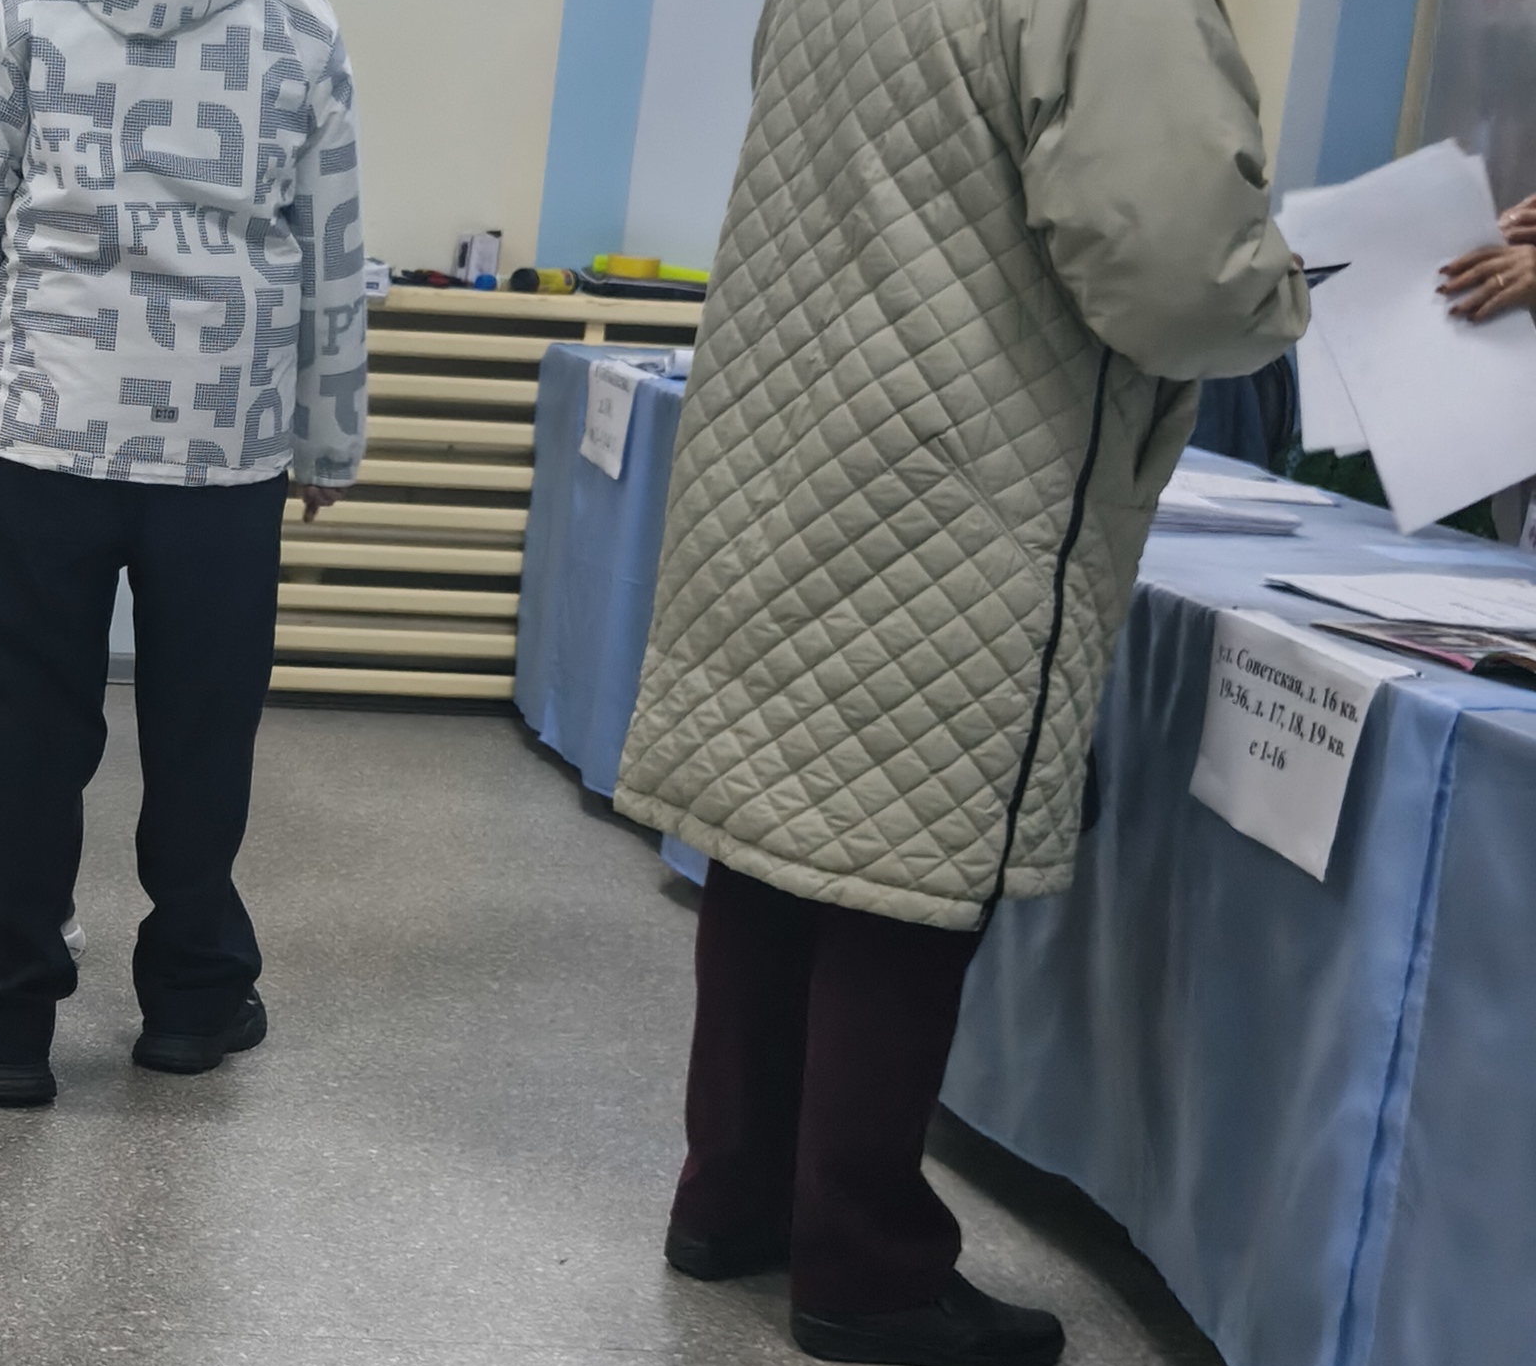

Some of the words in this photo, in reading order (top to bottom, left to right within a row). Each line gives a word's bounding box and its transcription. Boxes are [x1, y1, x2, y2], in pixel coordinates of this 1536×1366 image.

[1236, 649, 1303, 698] Советская,
[1322, 687, 1338, 712] 16
[1339, 701, 1358, 723] кв.
[1259, 741, 1286, 770] 1-16
[1288, 711, 1304, 740] 18,
[1308, 722, 1326, 745] 19
[1327, 735, 1345, 758] кв.
